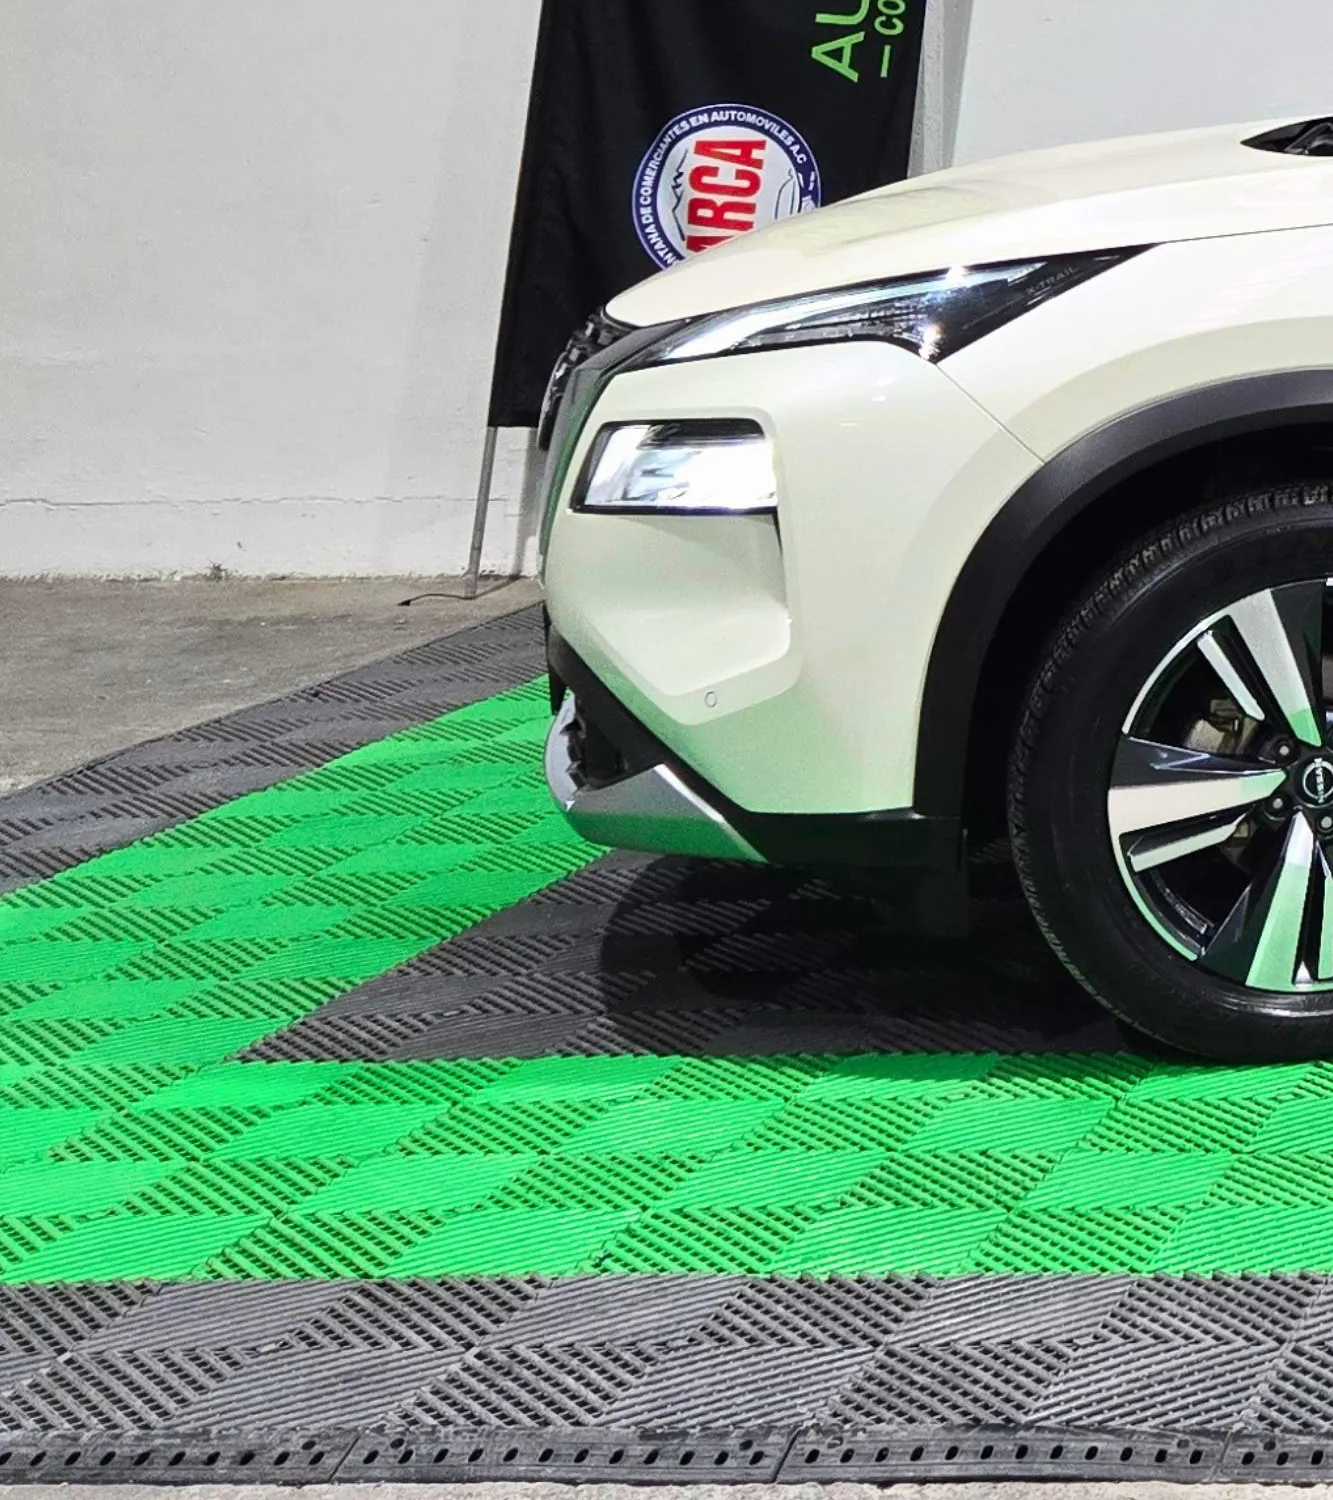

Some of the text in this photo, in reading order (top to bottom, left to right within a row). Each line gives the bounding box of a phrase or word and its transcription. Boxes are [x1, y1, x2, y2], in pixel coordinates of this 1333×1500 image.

[688, 113, 709, 127] EN
[710, 110, 795, 146] AUTOMOVILES
[639, 120, 691, 206] COMERCIANTES
[639, 205, 655, 225] DE
